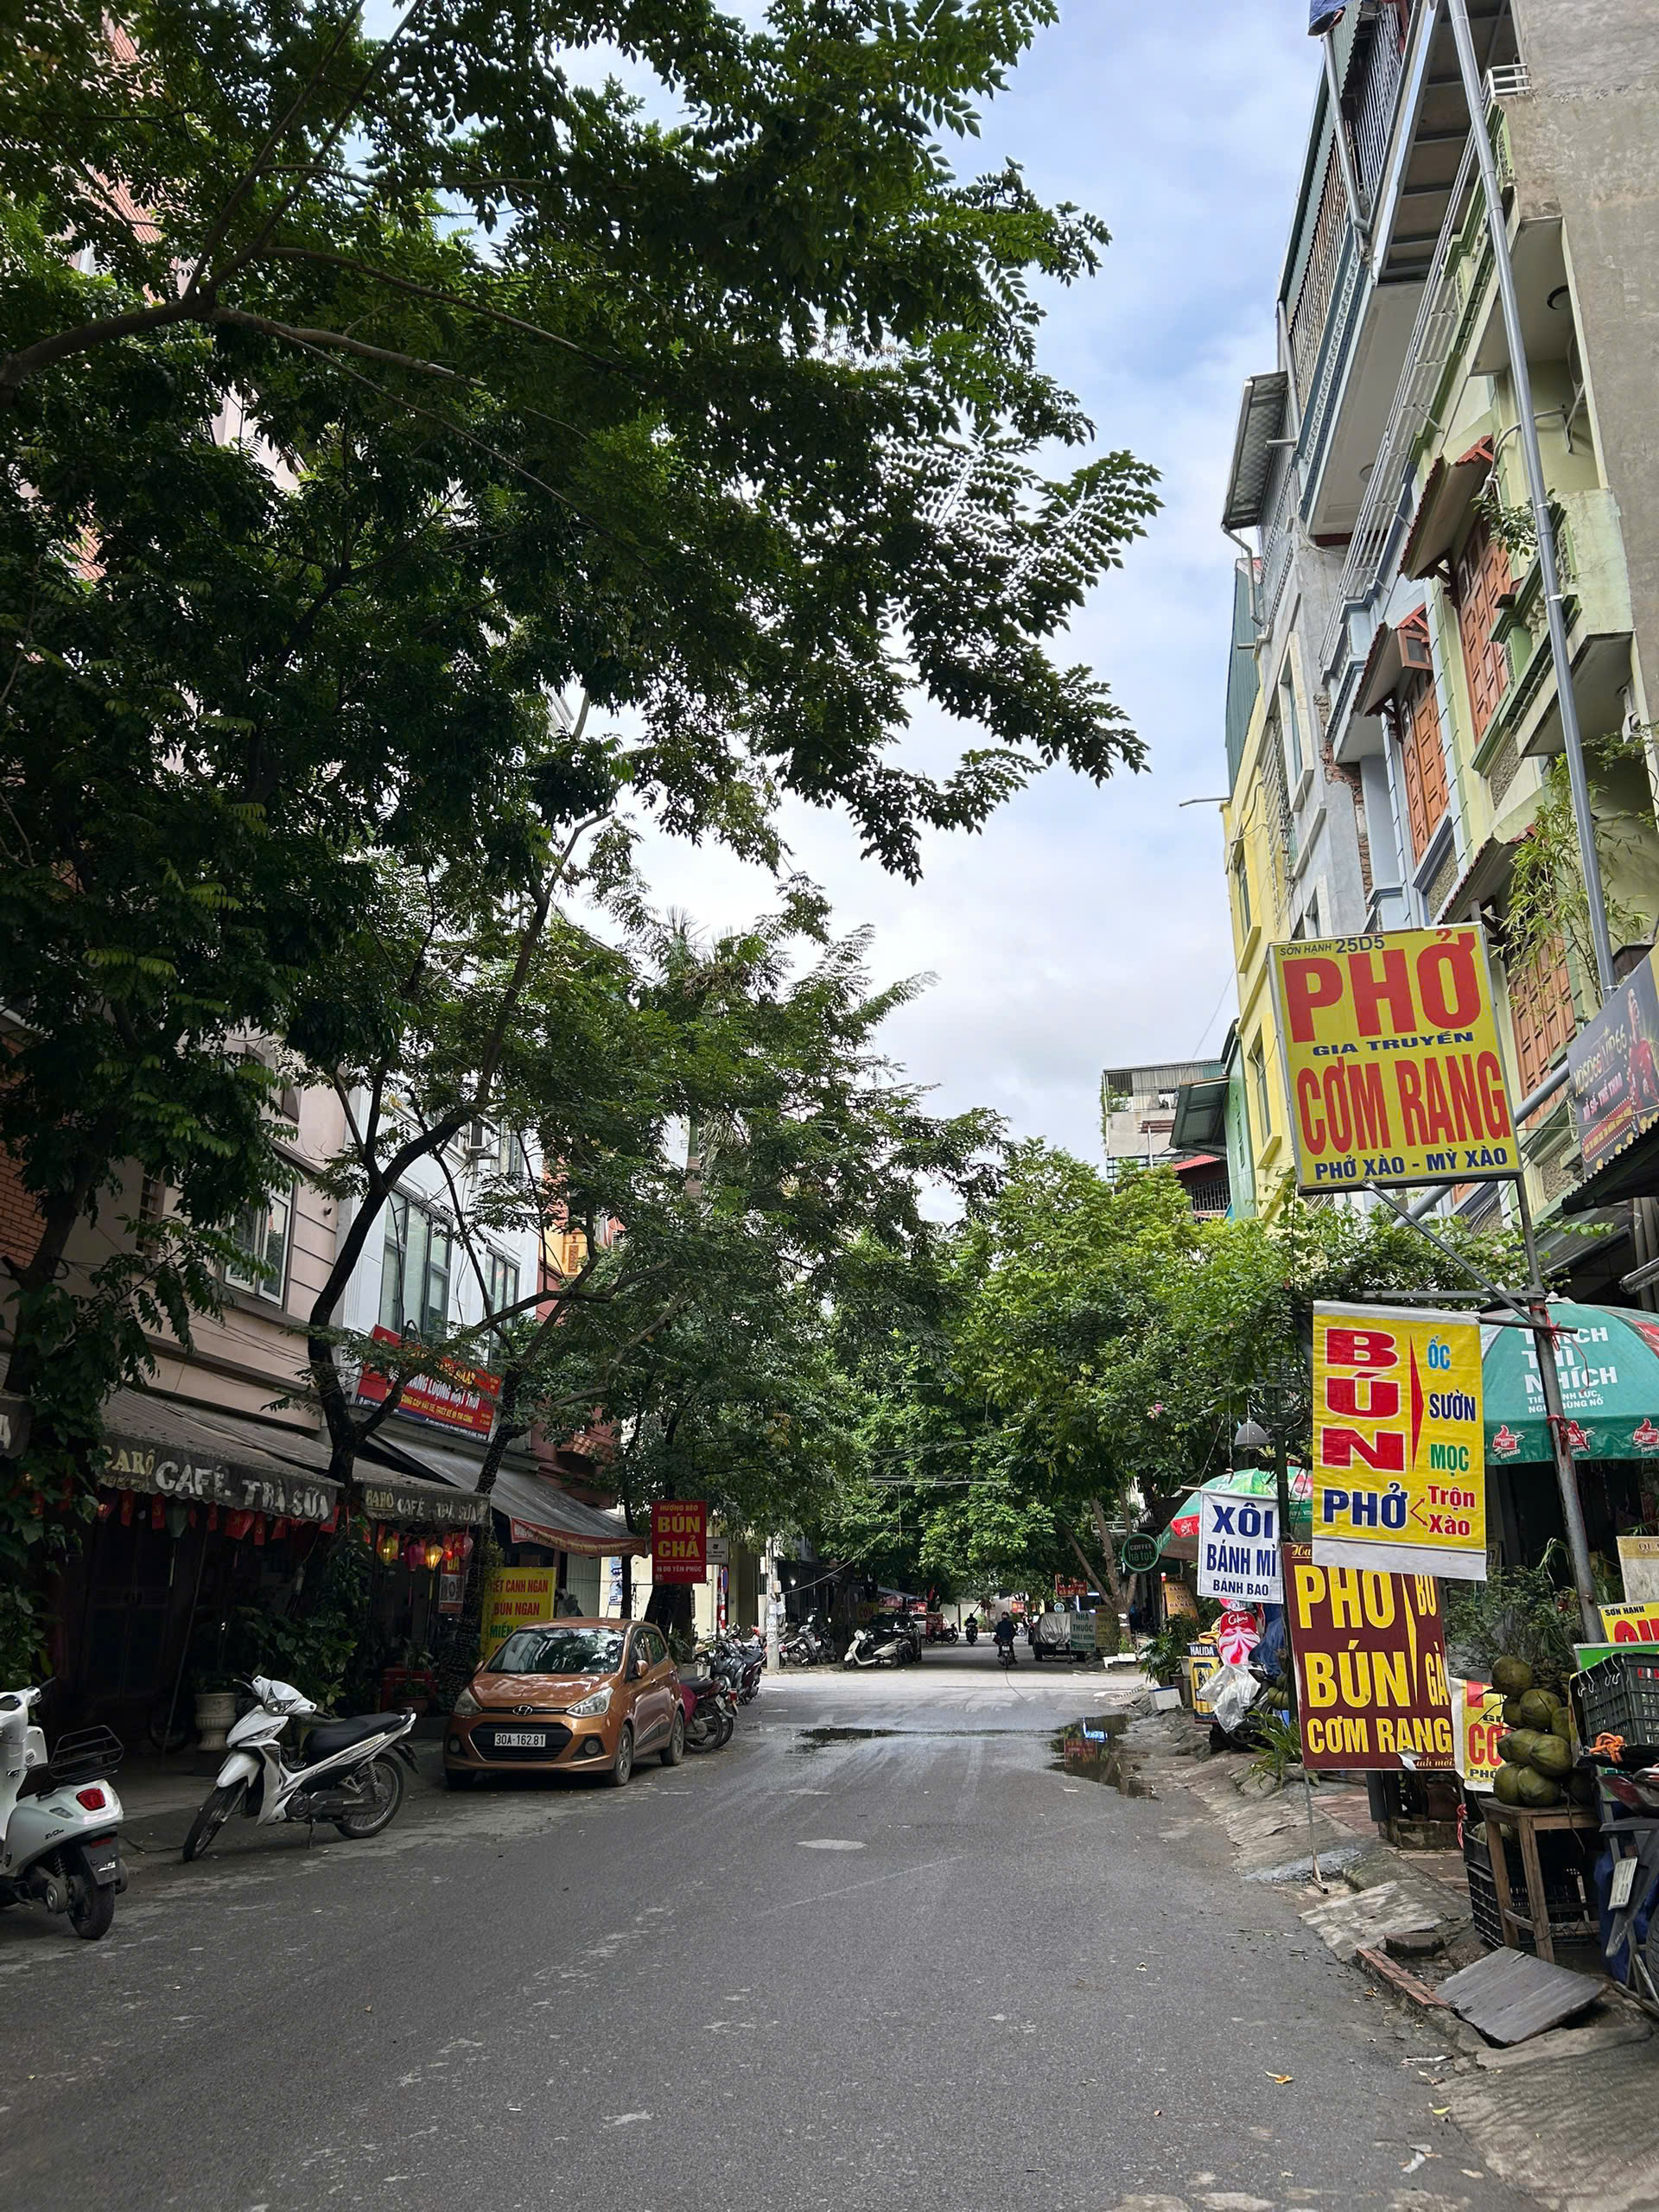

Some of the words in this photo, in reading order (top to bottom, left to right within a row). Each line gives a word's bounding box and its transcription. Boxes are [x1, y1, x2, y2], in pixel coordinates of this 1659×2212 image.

[1280, 946, 1301, 956] SƠN
[1304, 943, 1332, 955] HẠNH
[1335, 936, 1385, 954] 25D5
[1282, 928, 1481, 1043] PHỞ
[1313, 1042, 1358, 1057] GIA
[1297, 1056, 1392, 1155] CƠM
[1394, 1051, 1512, 1147] RANG
[1315, 1154, 1357, 1180] PHỞ
[1363, 1154, 1404, 1176] XÀO
[1426, 1148, 1457, 1172] MỲ
[1465, 1145, 1508, 1167] XÀO
[1427, 1336, 1451, 1370] ỐC
[1322, 1327, 1405, 1471] BÚN
[1429, 1389, 1476, 1421] SƯỜN
[1430, 1444, 1469, 1476] MỌC
[1324, 1483, 1408, 1529] PHỞ
[1427, 1485, 1475, 1510] Trộn
[658, 1512, 701, 1533] BÚN
[1211, 1502, 1274, 1538] XÔI
[1428, 1514, 1470, 1535] Xào
[658, 1535, 700, 1557] CHẢ
[1207, 1539, 1250, 1575] BÁNH
[1256, 1544, 1277, 1577] MÌ
[1213, 1578, 1243, 1594] BÁNH
[1247, 1583, 1269, 1596] BAO
[1605, 1607, 1622, 1617] SƠN
[1190, 1645, 1215, 1656] HALIDA
[1304, 1639, 1411, 1707] BÚN
[1425, 1642, 1449, 1707] GÀ
[1306, 1715, 1370, 1754] CƠM
[1376, 1717, 1452, 1754] RANG
